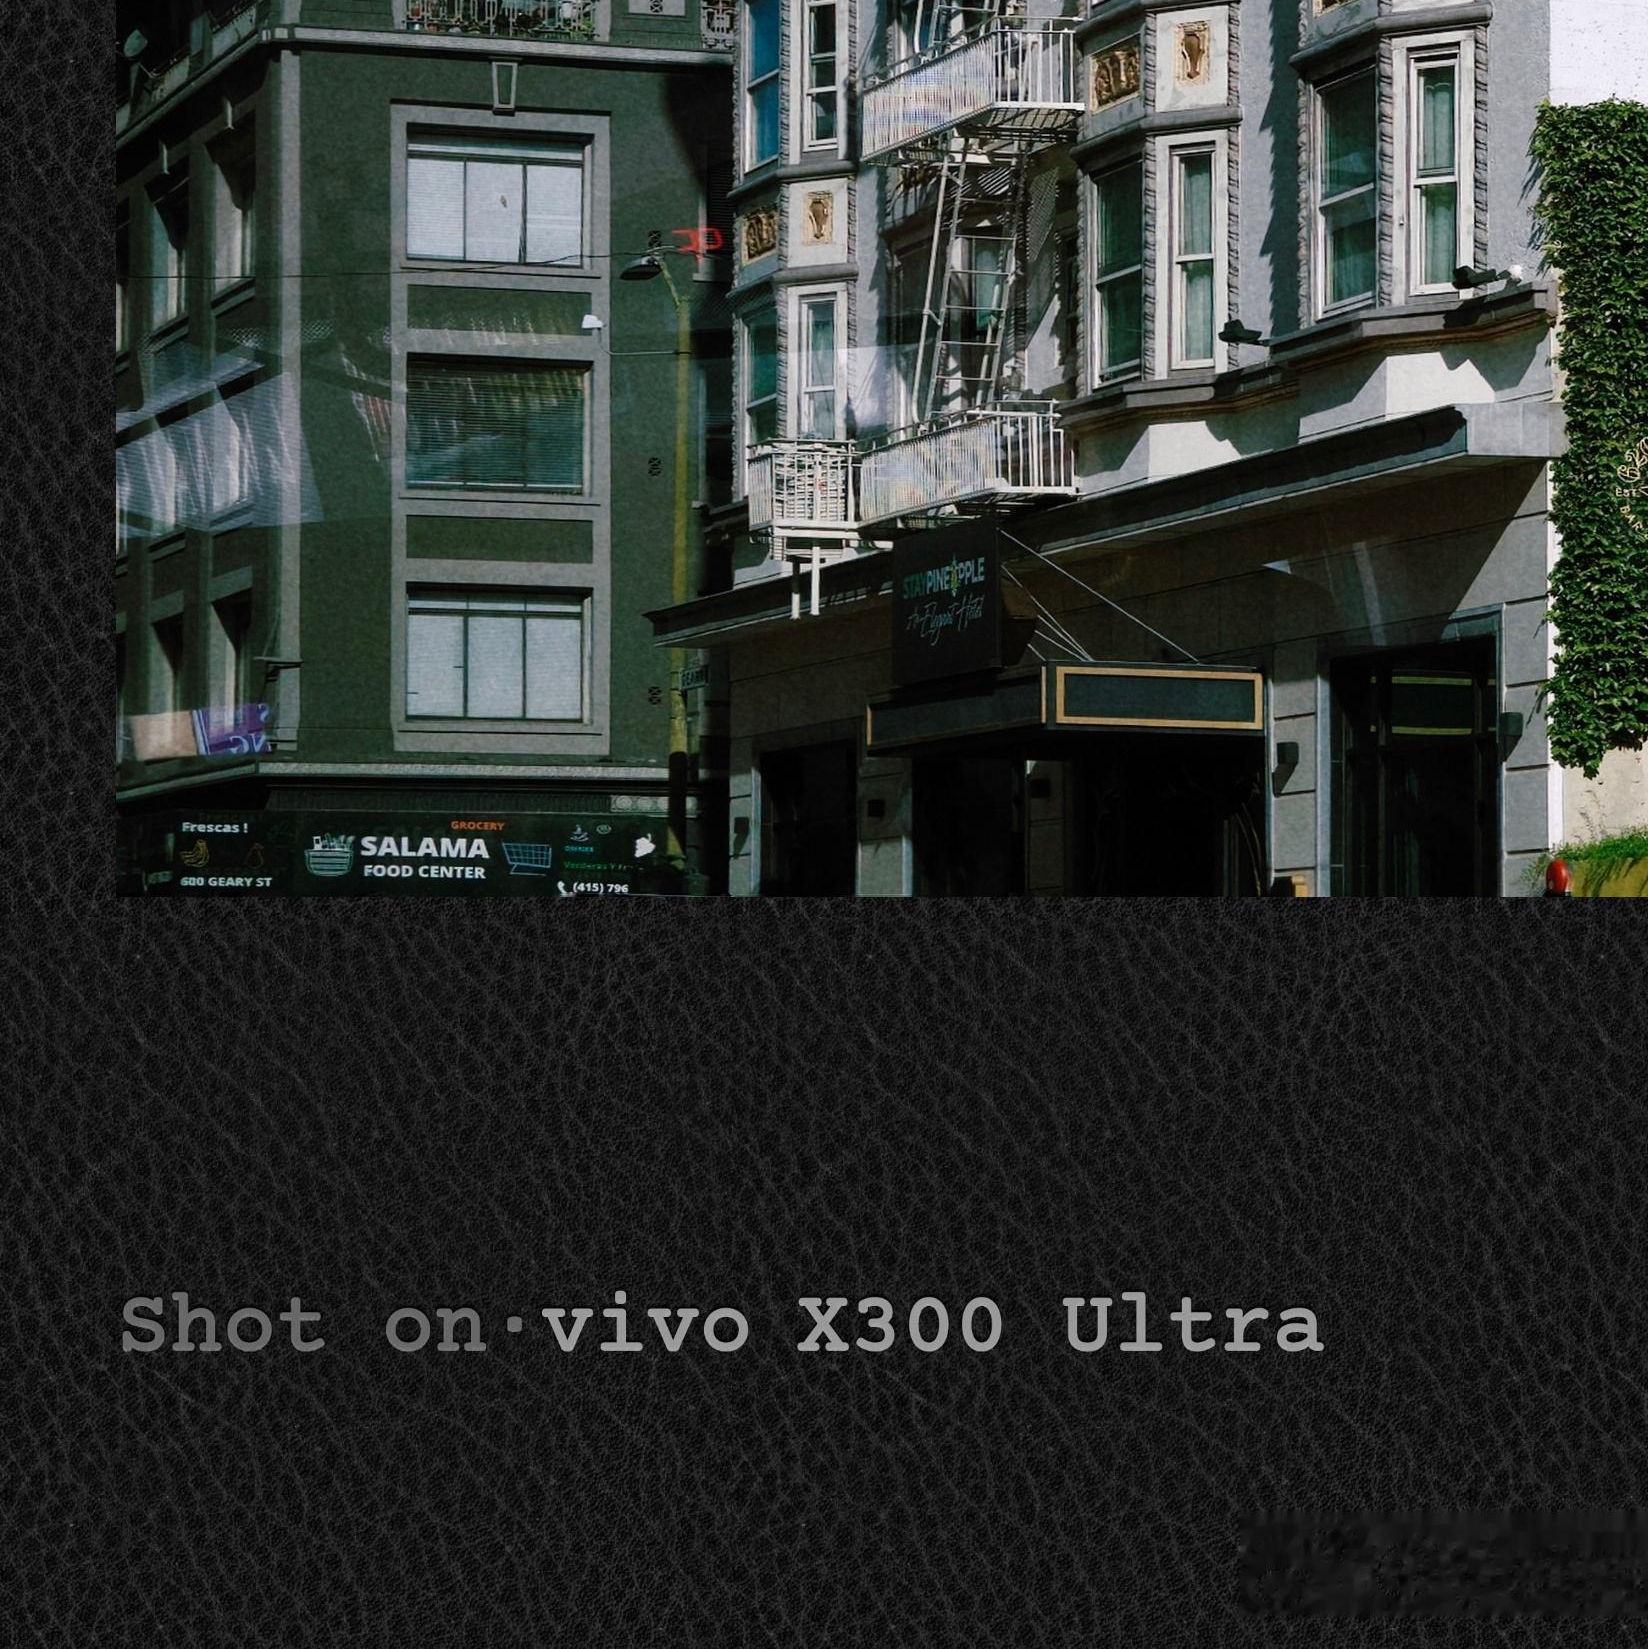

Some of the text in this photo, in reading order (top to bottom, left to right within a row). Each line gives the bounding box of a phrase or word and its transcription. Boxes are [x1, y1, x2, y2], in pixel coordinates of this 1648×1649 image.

[181, 821, 240, 833] Frescas
[451, 820, 505, 831] GROCERY
[360, 835, 490, 859] SALAMA
[363, 864, 487, 880] FOOD CENTER
[208, 877, 253, 887] GEARY
[256, 877, 273, 888] ST
[572, 881, 629, 894] (415) 796
